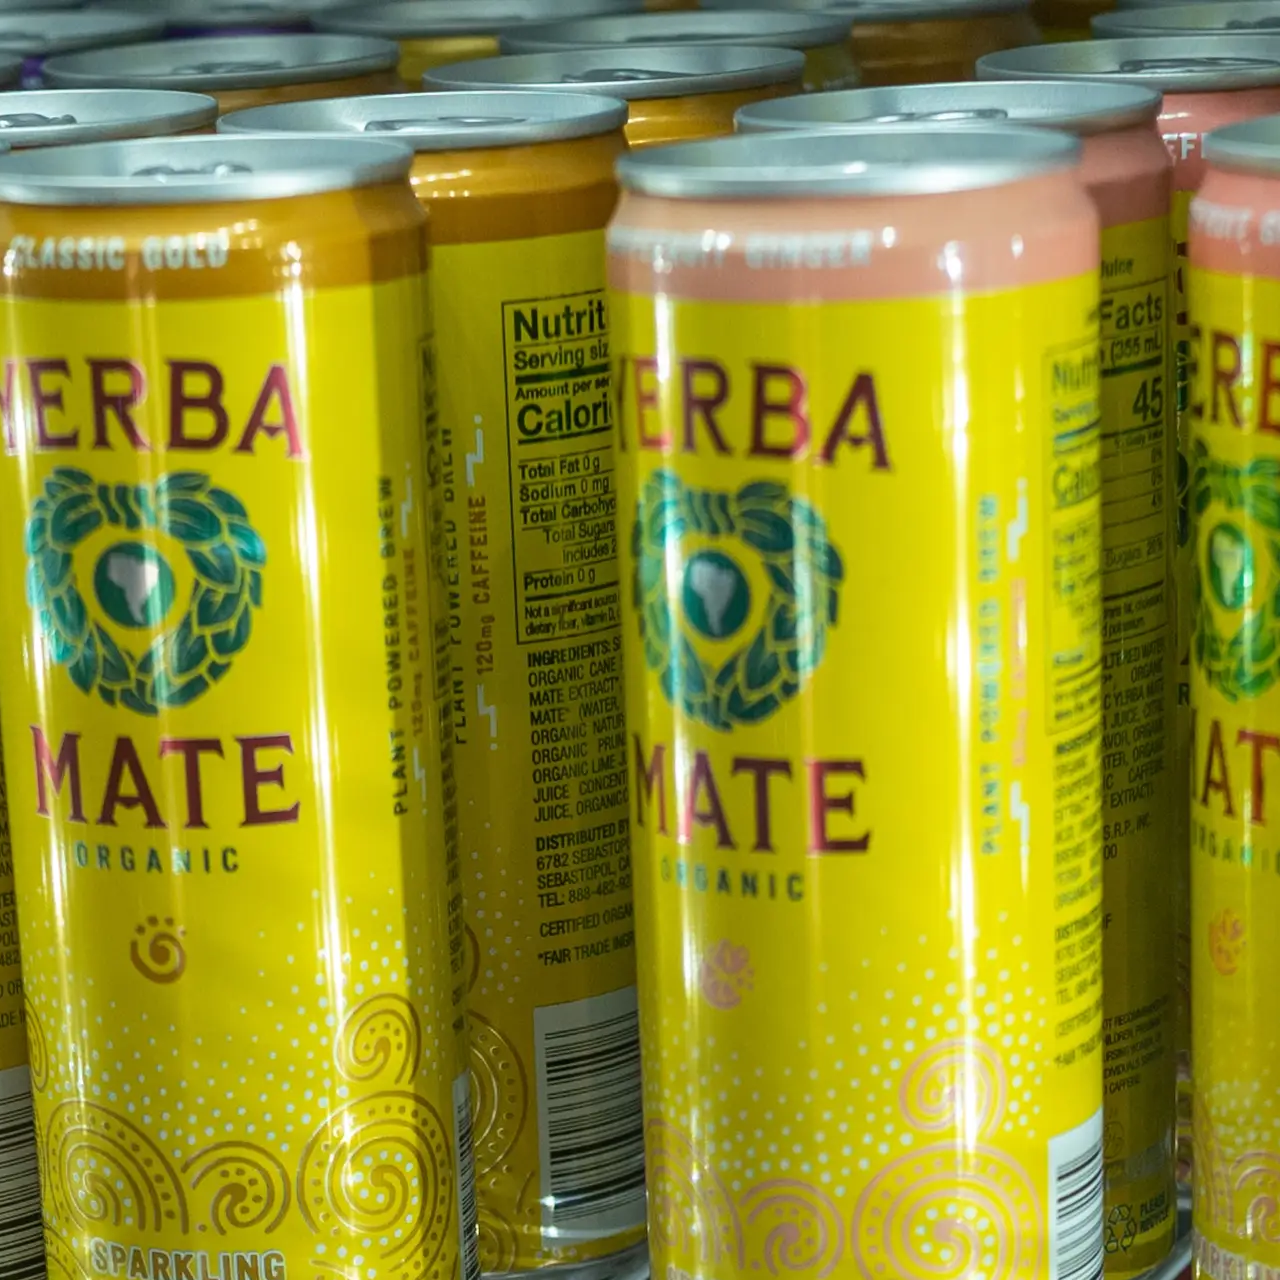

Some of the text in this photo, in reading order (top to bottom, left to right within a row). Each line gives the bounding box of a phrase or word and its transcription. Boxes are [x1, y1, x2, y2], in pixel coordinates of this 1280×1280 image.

[9, 235, 125, 270] CLASSIC
[514, 346, 584, 370] Serving
[1132, 377, 1163, 422] 45
[468, 495, 491, 605] CAFFEINE
[29, 724, 301, 830] MATE
[632, 732, 872, 858] MATE
[76, 840, 240, 874] ORGANIC
[660, 860, 805, 901] ORGANIC
